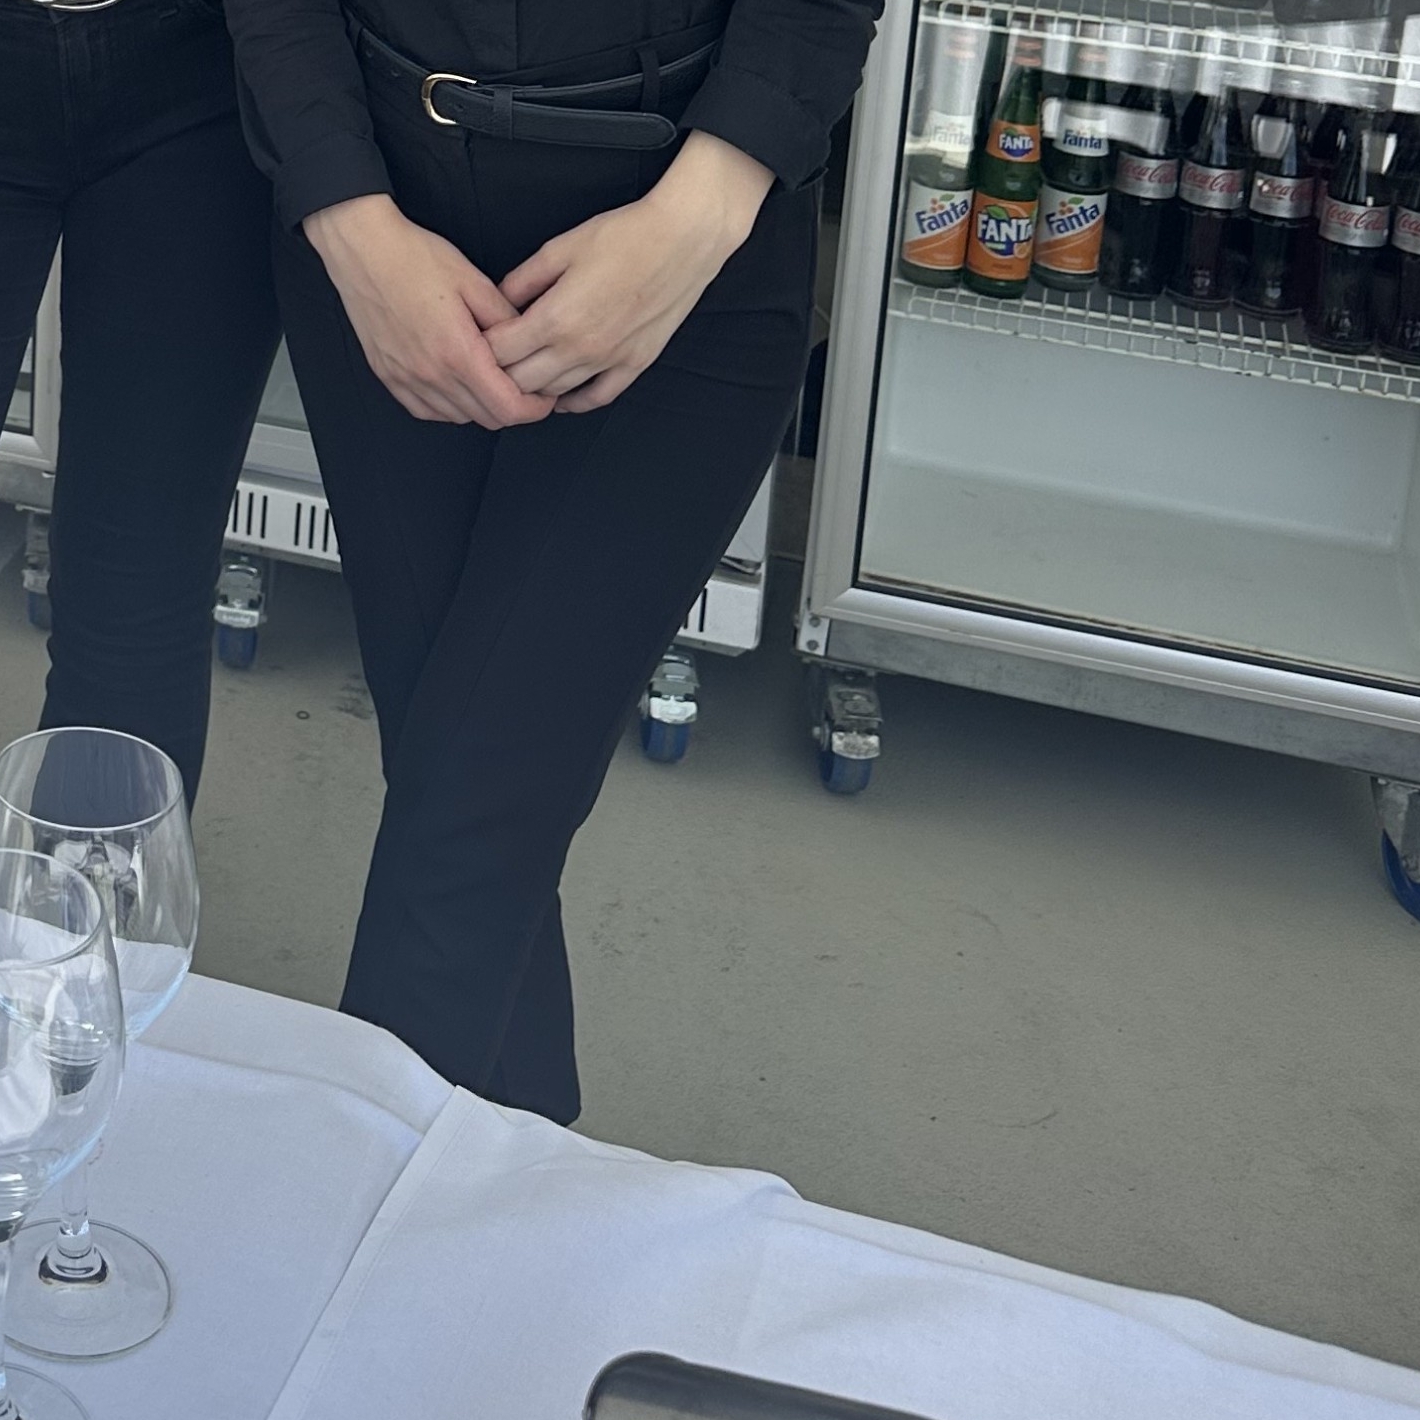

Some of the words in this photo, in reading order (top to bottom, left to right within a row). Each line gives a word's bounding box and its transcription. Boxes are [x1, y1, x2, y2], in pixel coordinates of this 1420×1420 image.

[1063, 129, 1102, 150] Fanta
[915, 198, 970, 234] Fanta
[1045, 202, 1101, 235] Fanta
